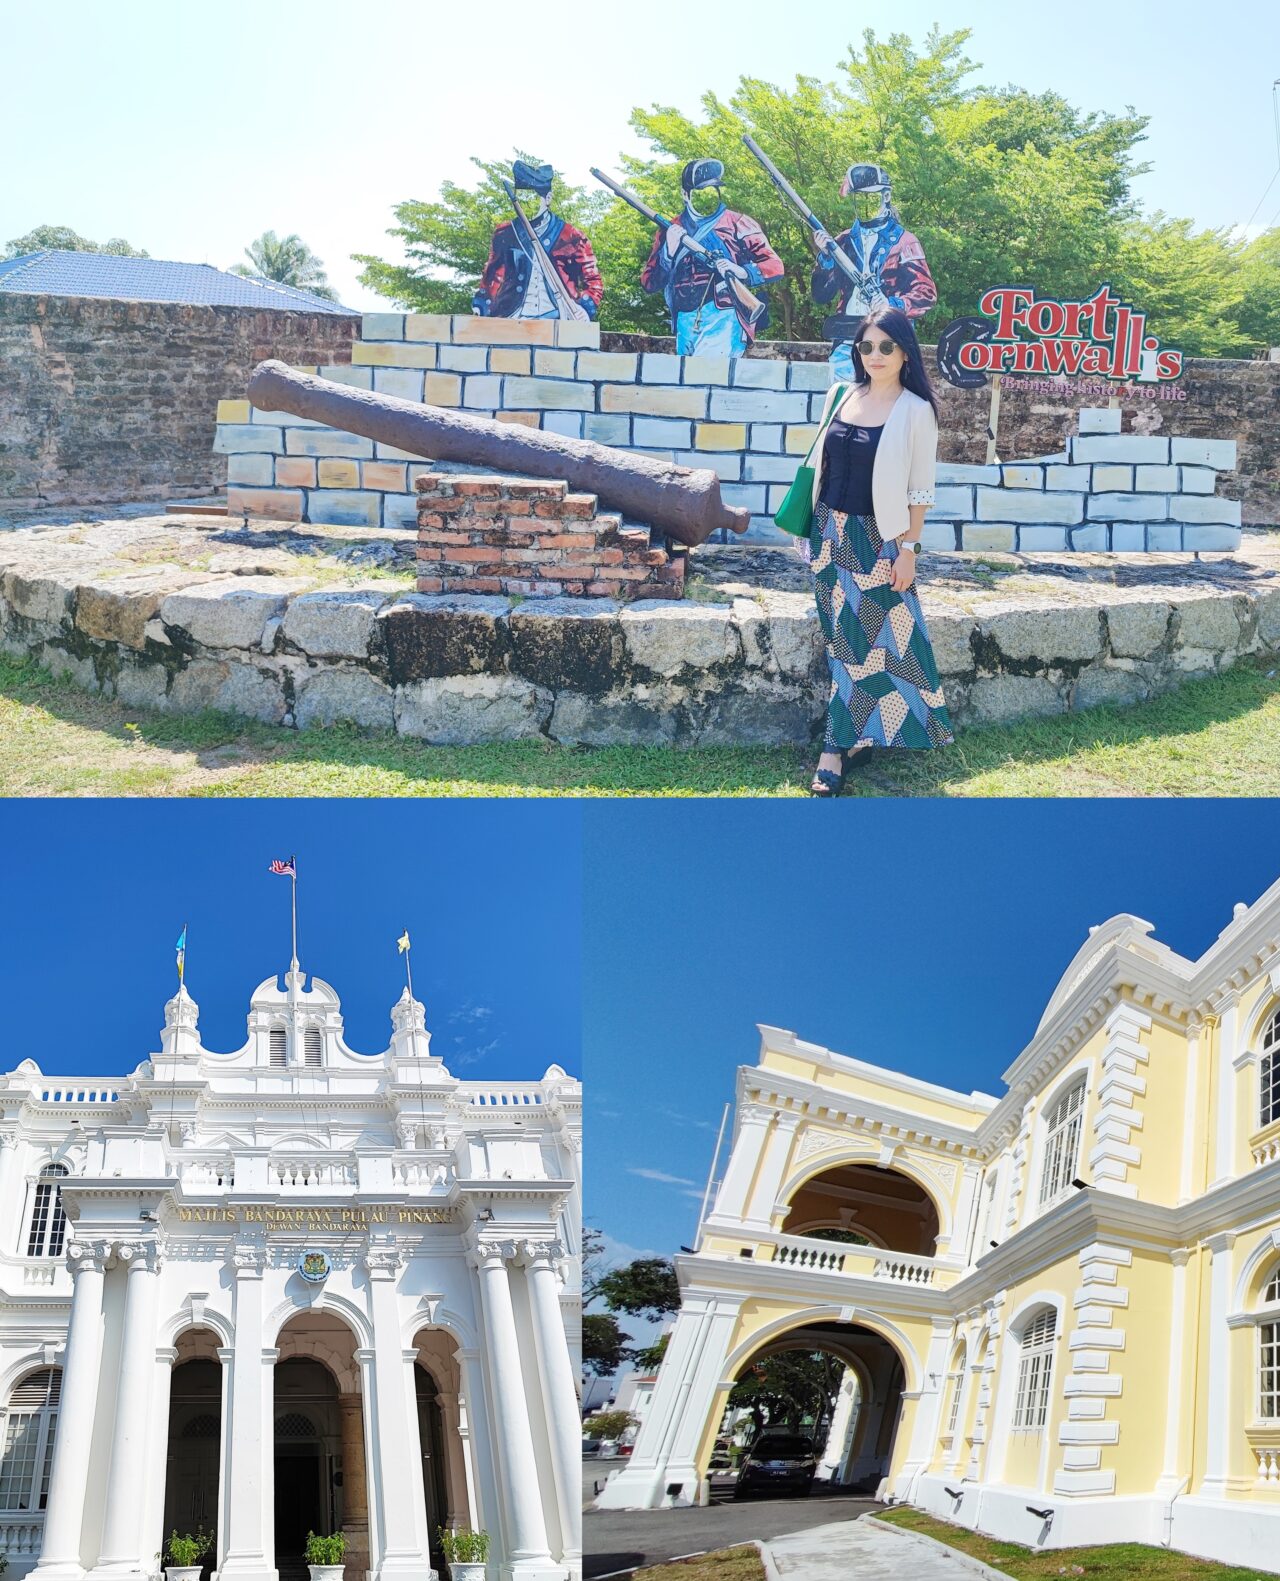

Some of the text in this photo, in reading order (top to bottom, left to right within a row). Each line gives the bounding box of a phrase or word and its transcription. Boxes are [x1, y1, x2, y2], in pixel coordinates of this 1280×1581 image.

[980, 283, 1120, 342] Fort
[937, 305, 1184, 389] Cornwallis
[1000, 375, 1187, 401] Bringing history to life
[245, 1210, 332, 1222] BANDARAYA
[342, 1211, 389, 1223] PULAU
[266, 1222, 369, 1232] DEWAN BANDARAYA
